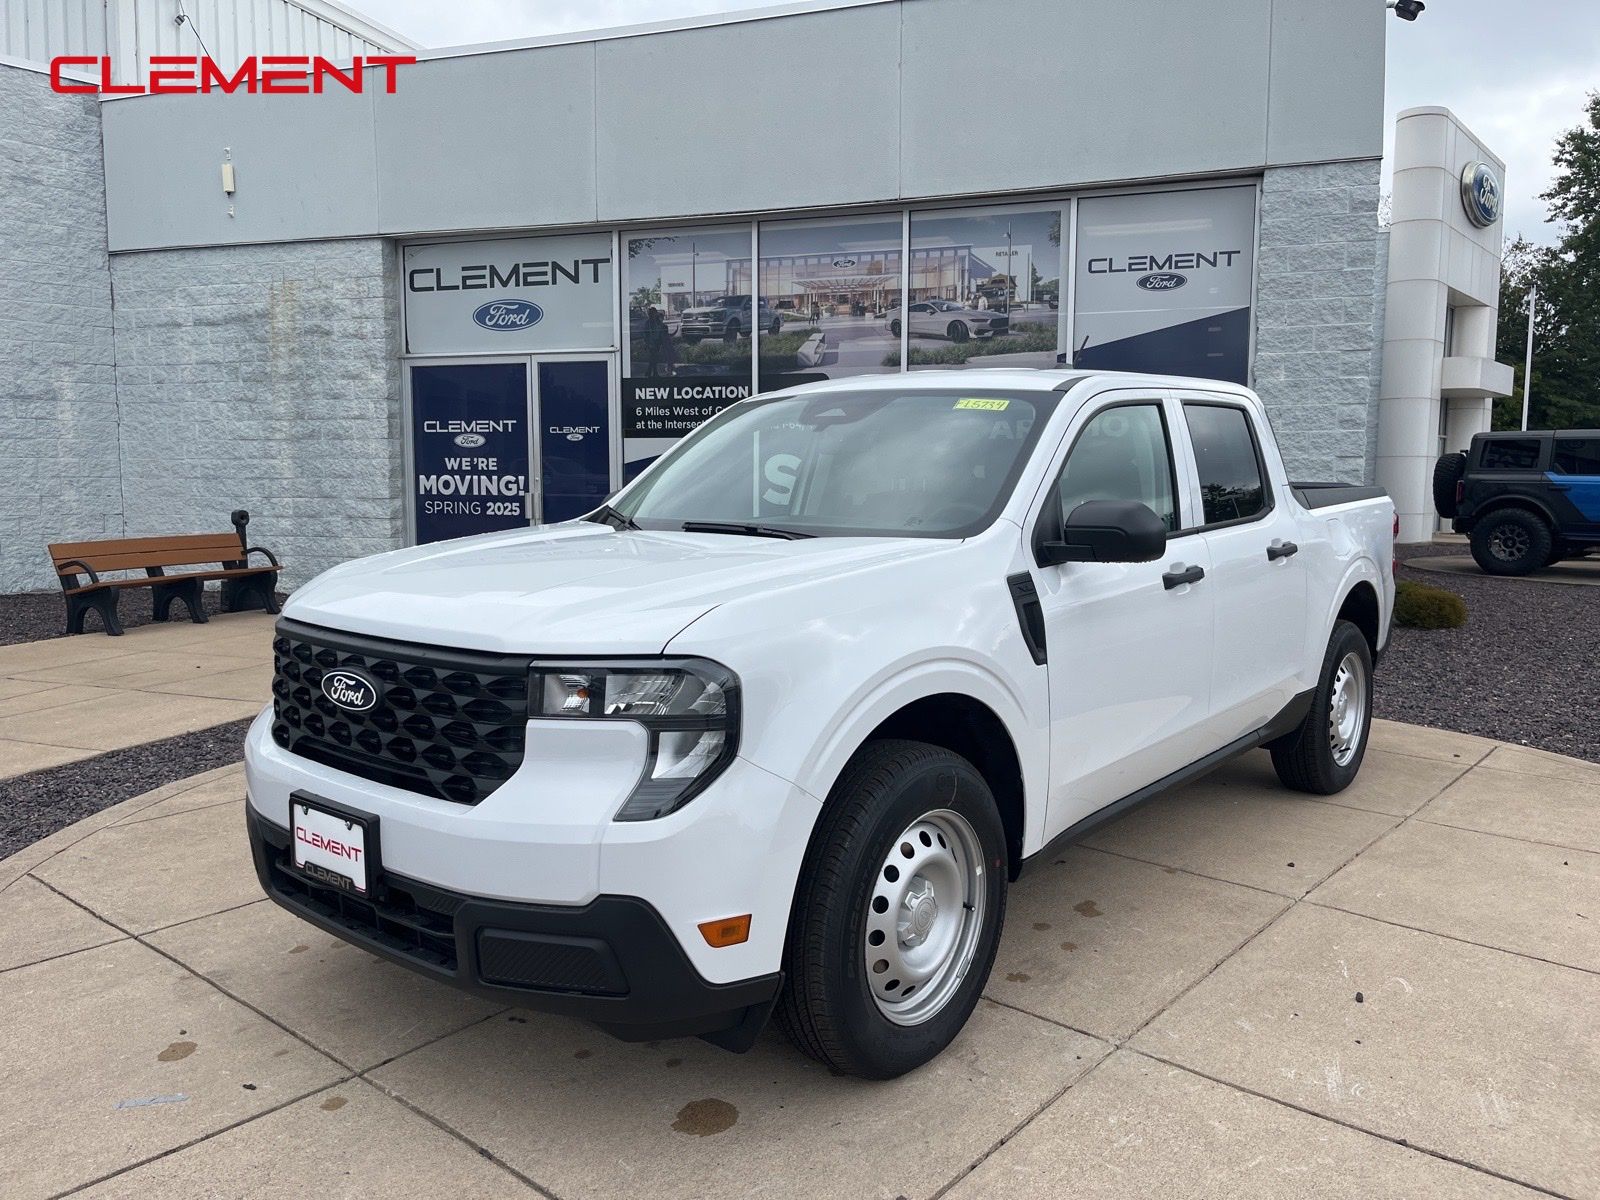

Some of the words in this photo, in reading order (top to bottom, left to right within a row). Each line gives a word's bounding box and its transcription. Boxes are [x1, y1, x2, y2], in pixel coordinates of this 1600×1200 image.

[1088, 250, 1241, 274] CLEMENT
[409, 257, 611, 293] CLEMENT
[1146, 275, 1178, 289] Ford
[485, 304, 530, 326] Ford
[635, 387, 670, 400] NEW
[673, 385, 749, 399] LOCATION
[635, 406, 643, 416] 6
[645, 406, 670, 416] Miles
[673, 406, 699, 416] West
[701, 405, 713, 415] of
[423, 420, 517, 433] CLEMENT
[549, 426, 600, 434] CLEMENT
[635, 419, 645, 429] at
[647, 419, 662, 429] the
[444, 457, 498, 471] WE'RE
[419, 474, 525, 496] MOVING!
[425, 500, 481, 515] SPRING
[486, 501, 520, 516] 2025
[331, 676, 364, 706] Ford
[296, 826, 362, 862] CLEMENT
[305, 863, 351, 890] CLEMENT
